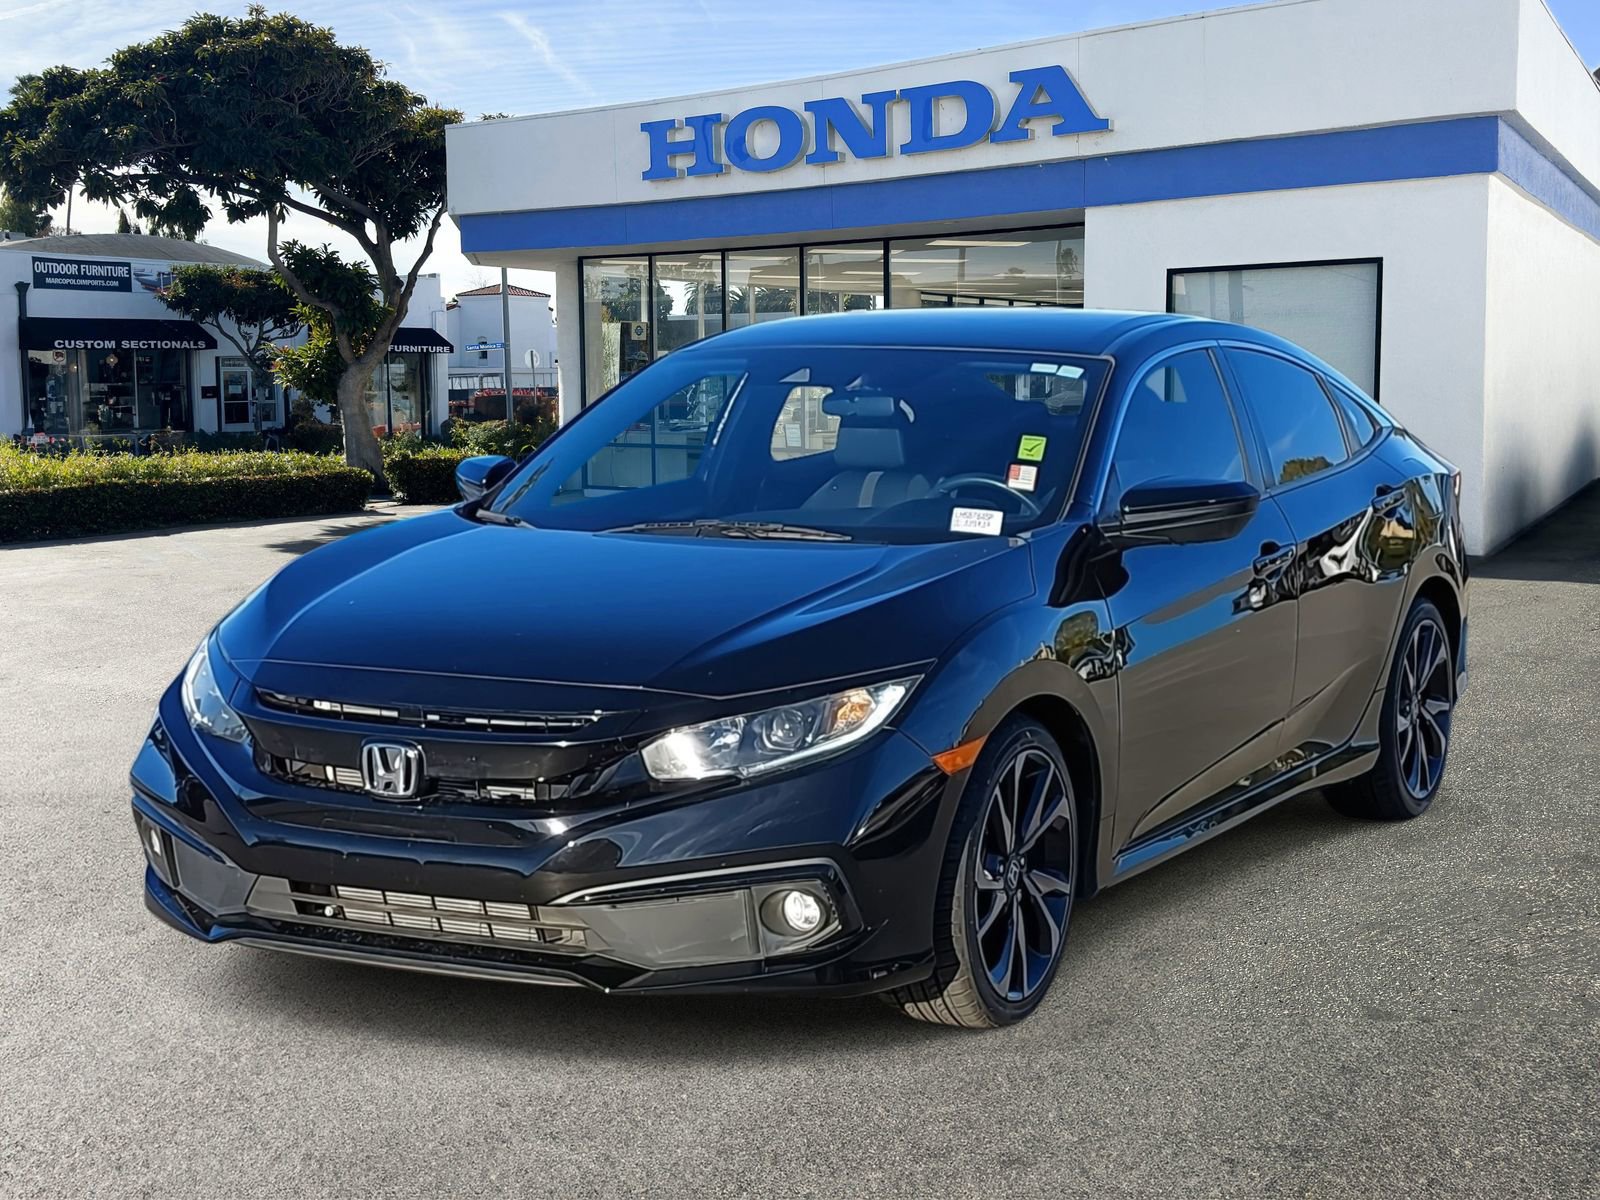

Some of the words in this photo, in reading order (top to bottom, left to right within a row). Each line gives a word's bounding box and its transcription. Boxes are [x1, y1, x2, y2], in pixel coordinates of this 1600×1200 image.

[641, 65, 1112, 181] HONDA
[34, 261, 79, 275] OUTDOOR
[80, 264, 130, 277] FURNITURE
[45, 277, 119, 287] MARCOPOLOIMPORTS.COM
[54, 340, 116, 349] CUSTOM
[121, 340, 206, 349] SECTIONALS
[388, 344, 450, 353] FURNITURE
